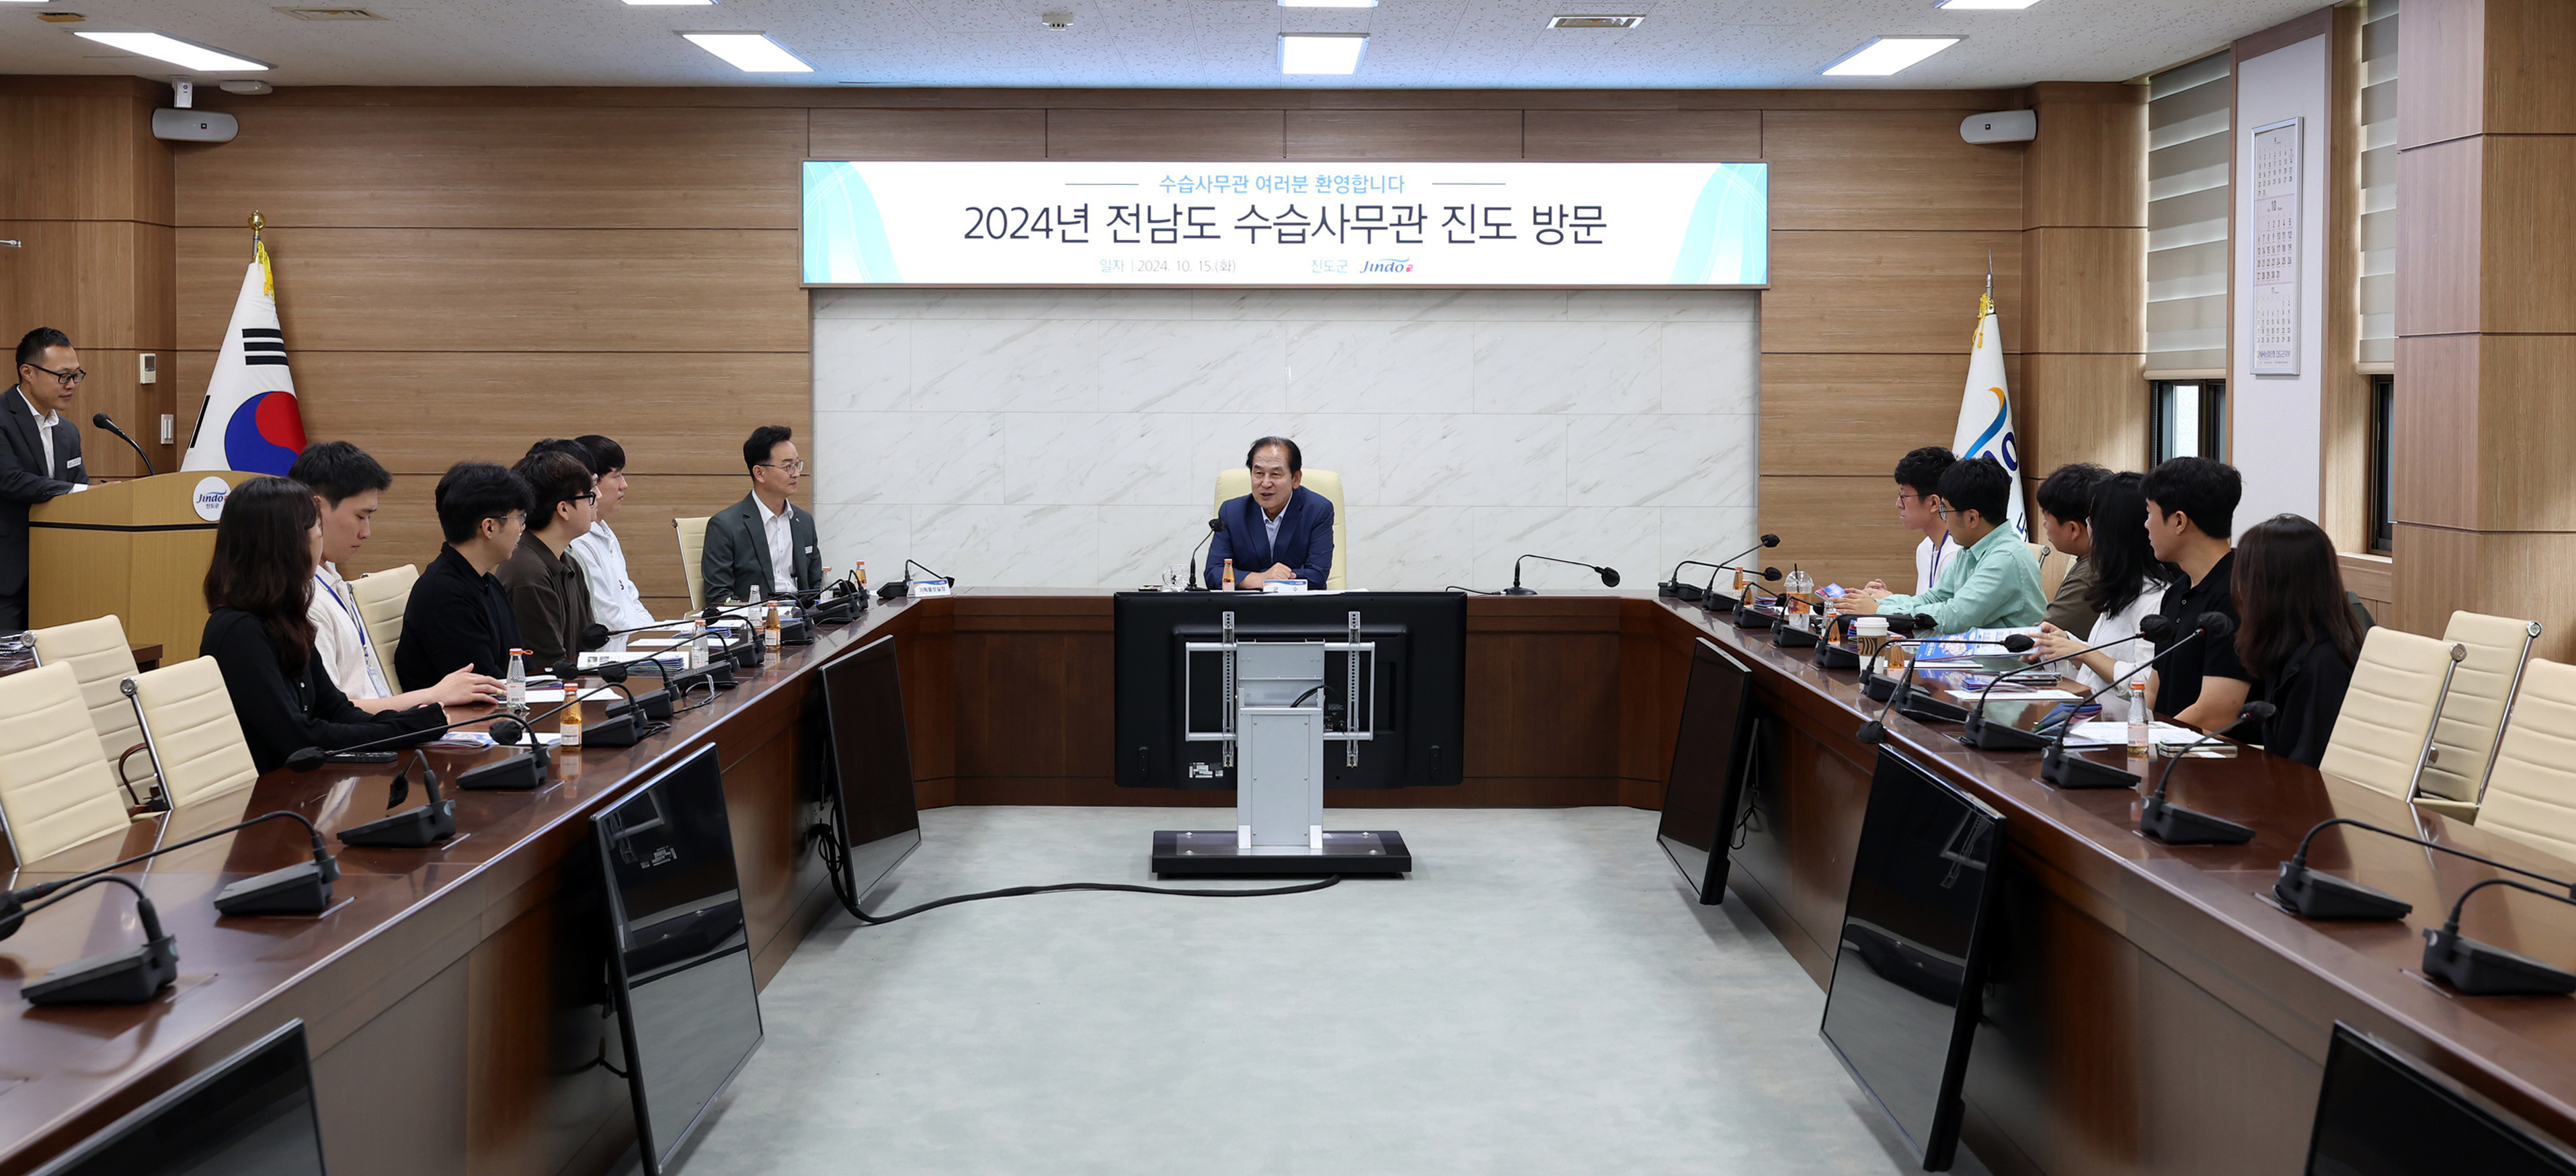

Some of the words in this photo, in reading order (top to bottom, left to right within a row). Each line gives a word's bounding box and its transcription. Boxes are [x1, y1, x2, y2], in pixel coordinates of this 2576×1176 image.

[1159, 175, 1249, 194] 수습사무관
[1256, 175, 1309, 194] 여러분
[1315, 175, 1405, 194] 환영합니다
[2271, 200, 2277, 211] 10
[964, 203, 1088, 243] 2024년
[1106, 203, 1221, 244] 전남도
[1234, 203, 1427, 245] 수습사무관
[1441, 204, 1517, 244] 진도
[1533, 204, 1607, 245] 방문
[1099, 260, 1125, 273] 일자
[1138, 260, 1170, 272] 2024.
[1176, 260, 1193, 272] 10.
[1199, 259, 1236, 274] 15.(화)
[1311, 259, 1349, 274] 진도군
[1359, 260, 1405, 274] Jindo
[196, 494, 224, 504] Jindo
